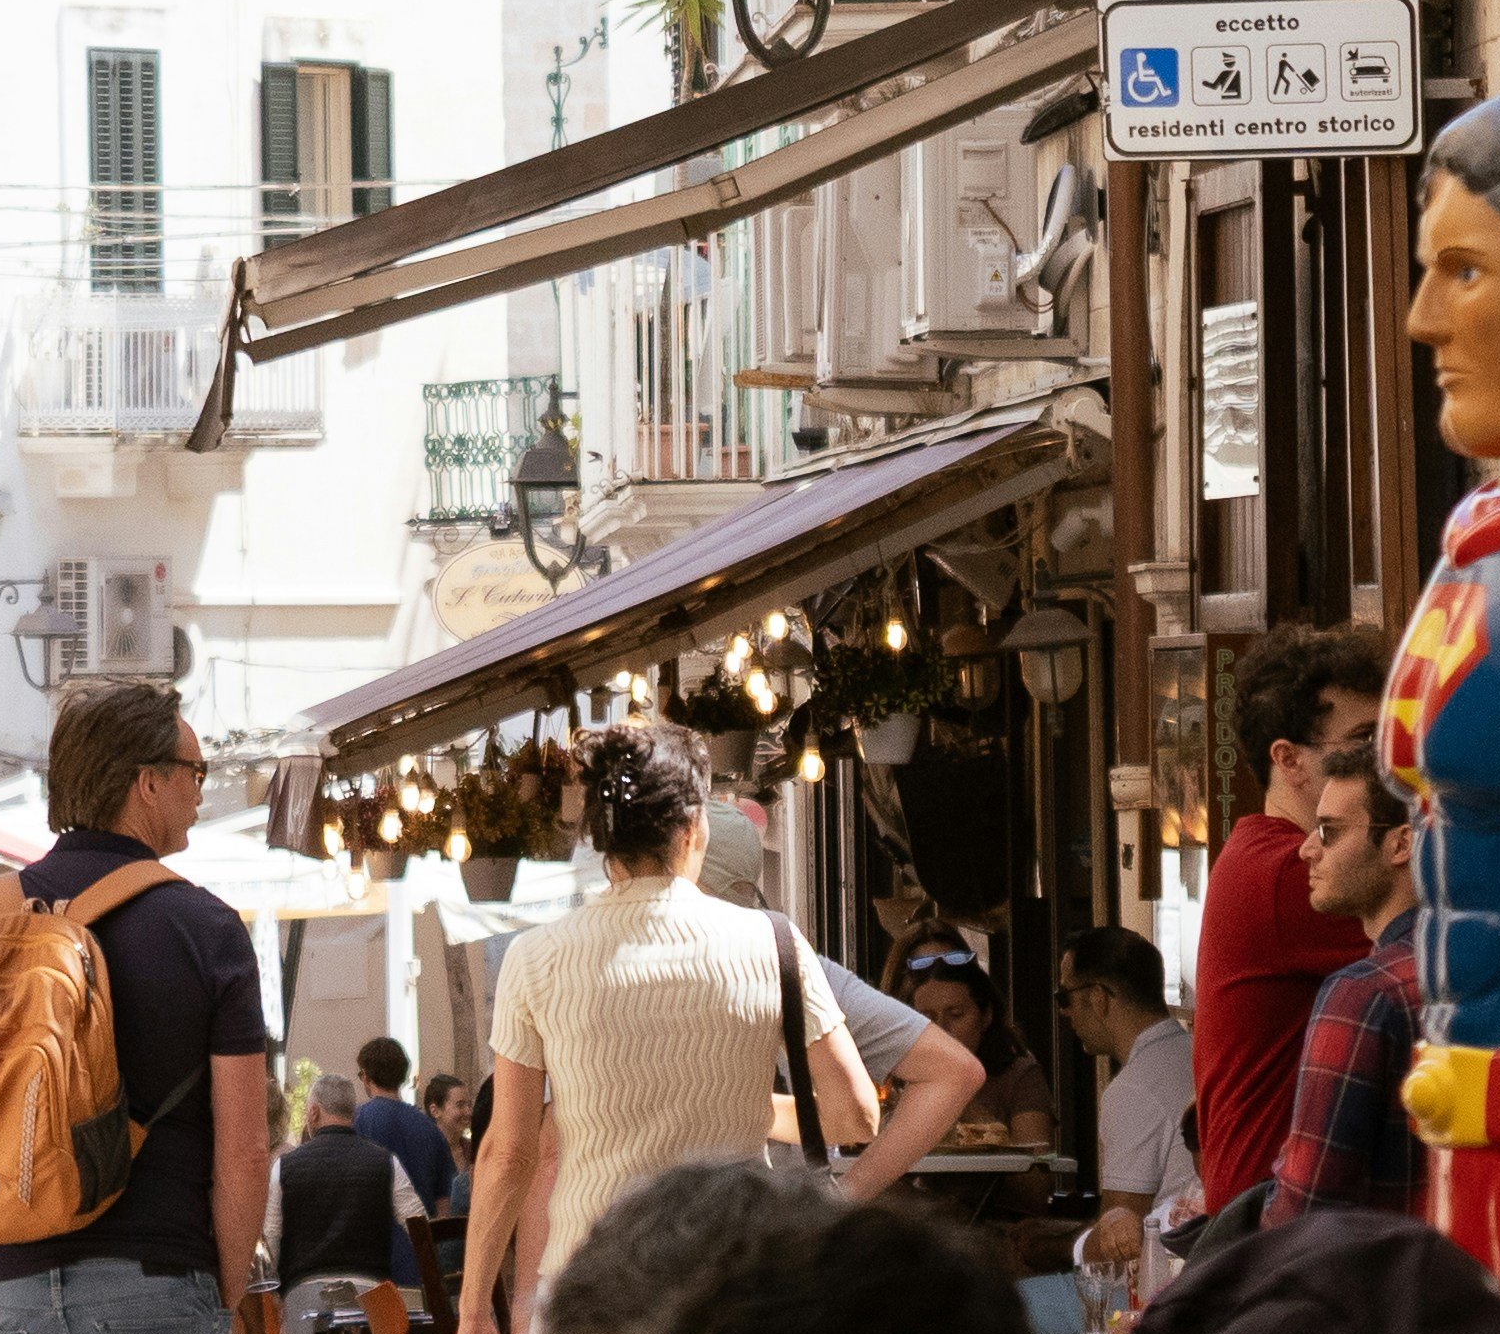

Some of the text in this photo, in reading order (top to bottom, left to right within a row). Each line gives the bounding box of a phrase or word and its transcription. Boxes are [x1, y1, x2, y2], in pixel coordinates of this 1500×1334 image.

[1216, 13, 1301, 33] eccetto
[1350, 88, 1393, 97] autorizzati
[1128, 114, 1396, 139] residenti centro storico
[1214, 648, 1238, 842] PRODOTTI
